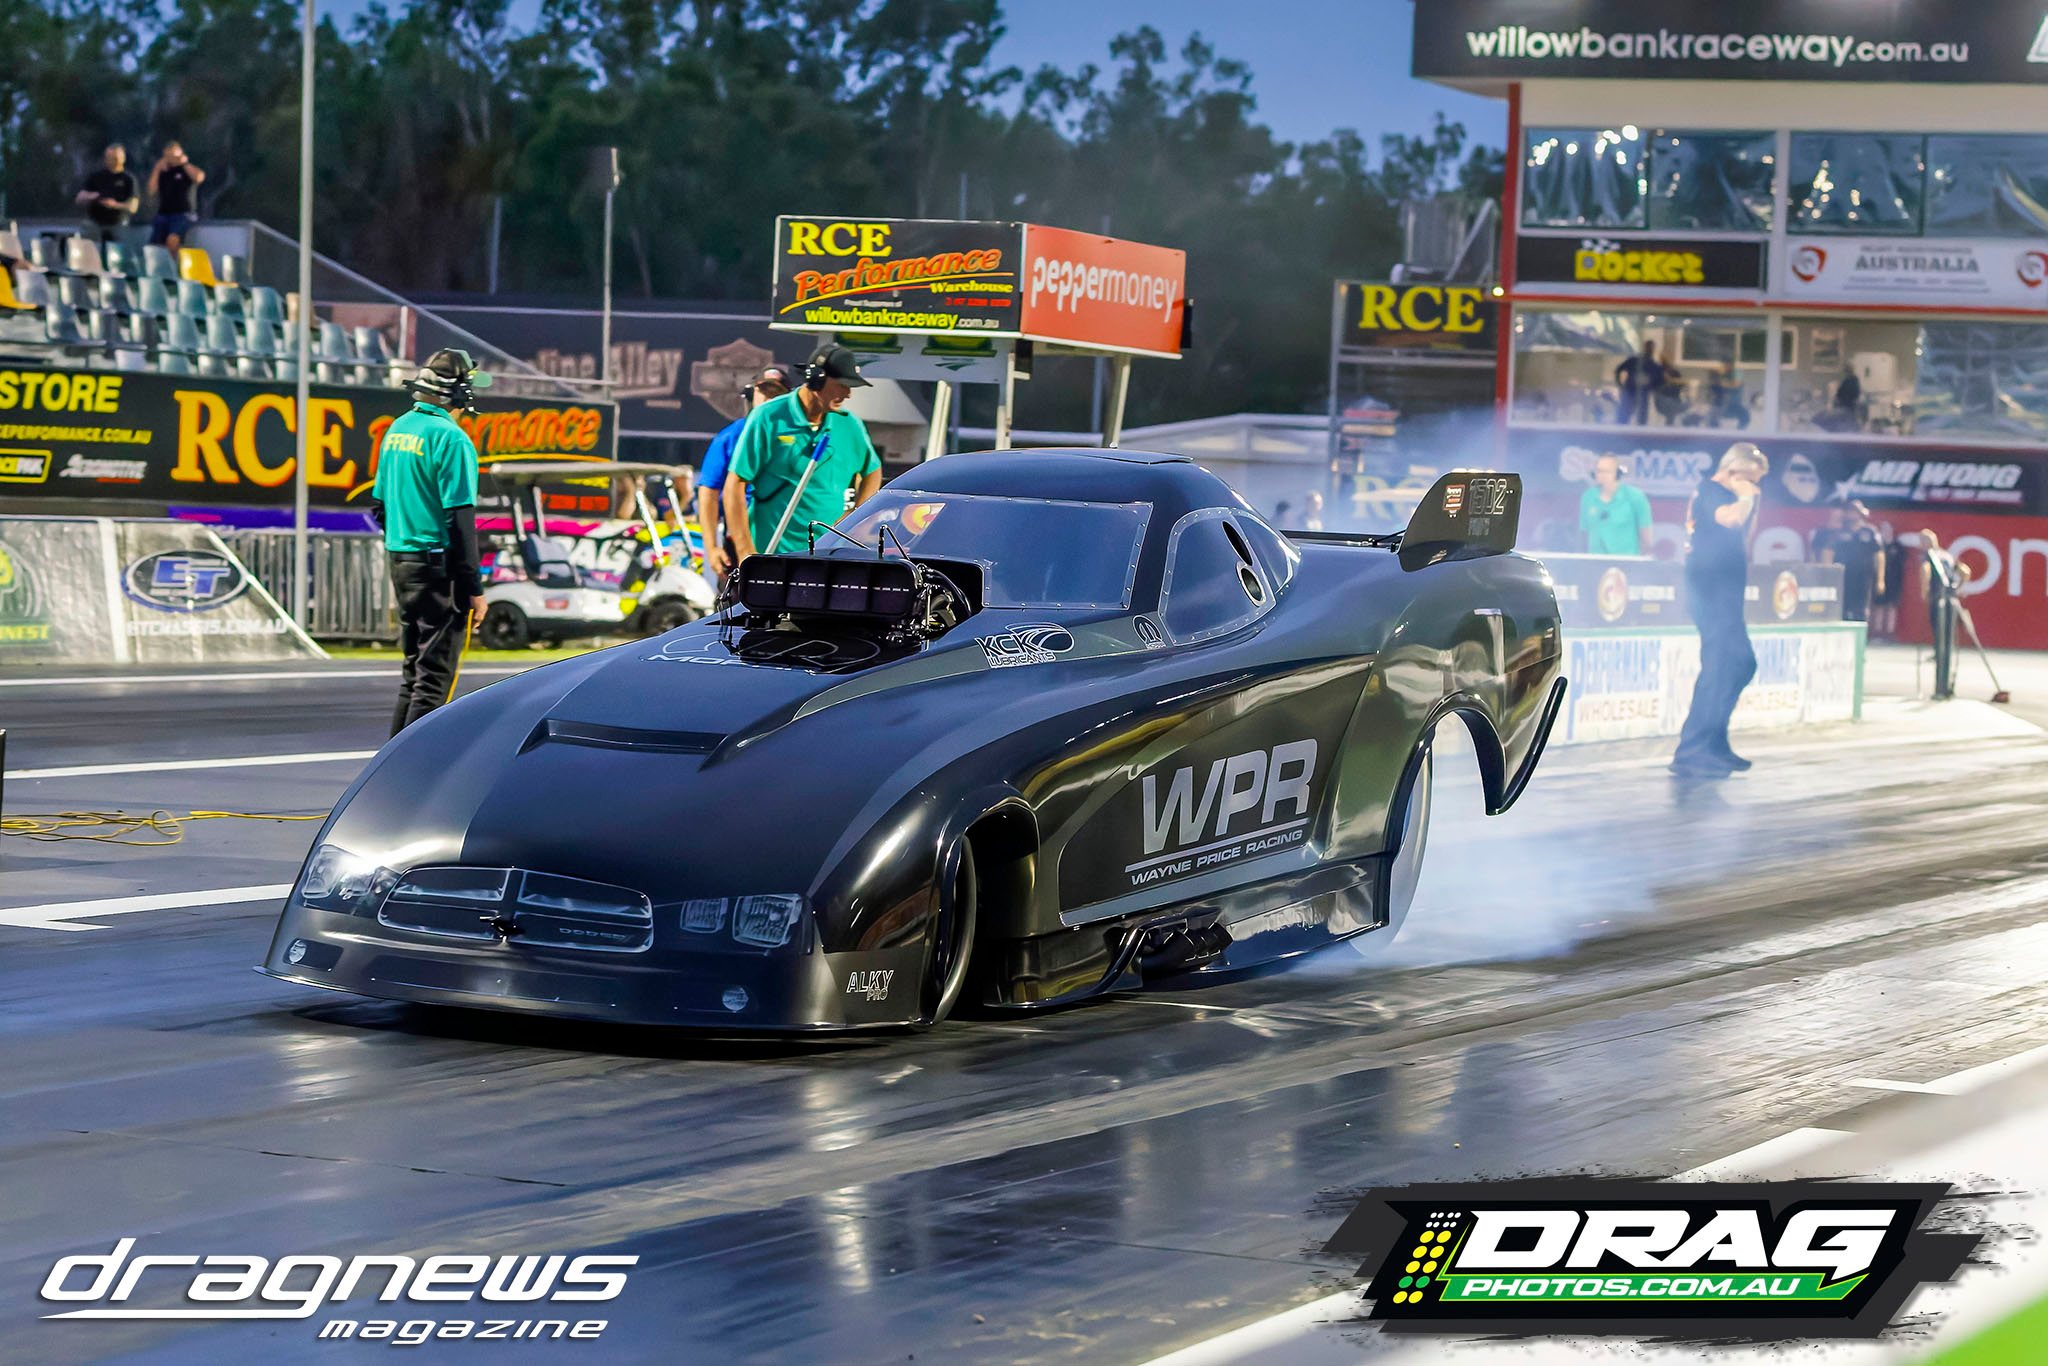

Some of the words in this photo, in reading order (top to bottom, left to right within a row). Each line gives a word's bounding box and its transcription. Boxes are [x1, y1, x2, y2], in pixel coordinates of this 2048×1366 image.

[1467, 26, 1969, 67] willowbankraceway.com.au
[787, 222, 893, 257] RCE
[793, 249, 1002, 301] Performance
[1855, 256, 1980, 273] AUSTRALIA
[929, 280, 1014, 294] Warehouse
[804, 306, 1000, 330] willowbankraceway.com.au
[1358, 284, 1485, 333] RCE
[0, 370, 123, 413] STORE
[170, 389, 357, 489] RCE
[1918, 462, 2024, 489] WONG
[975, 634, 1042, 658] KCK
[989, 651, 1057, 669] LUBRICANTS
[1142, 738, 1318, 855] WPR
[1131, 860, 1192, 886] WAYNE
[1196, 846, 1241, 868] PRICE
[1245, 829, 1304, 854] RACING
[845, 969, 895, 994] ALKY
